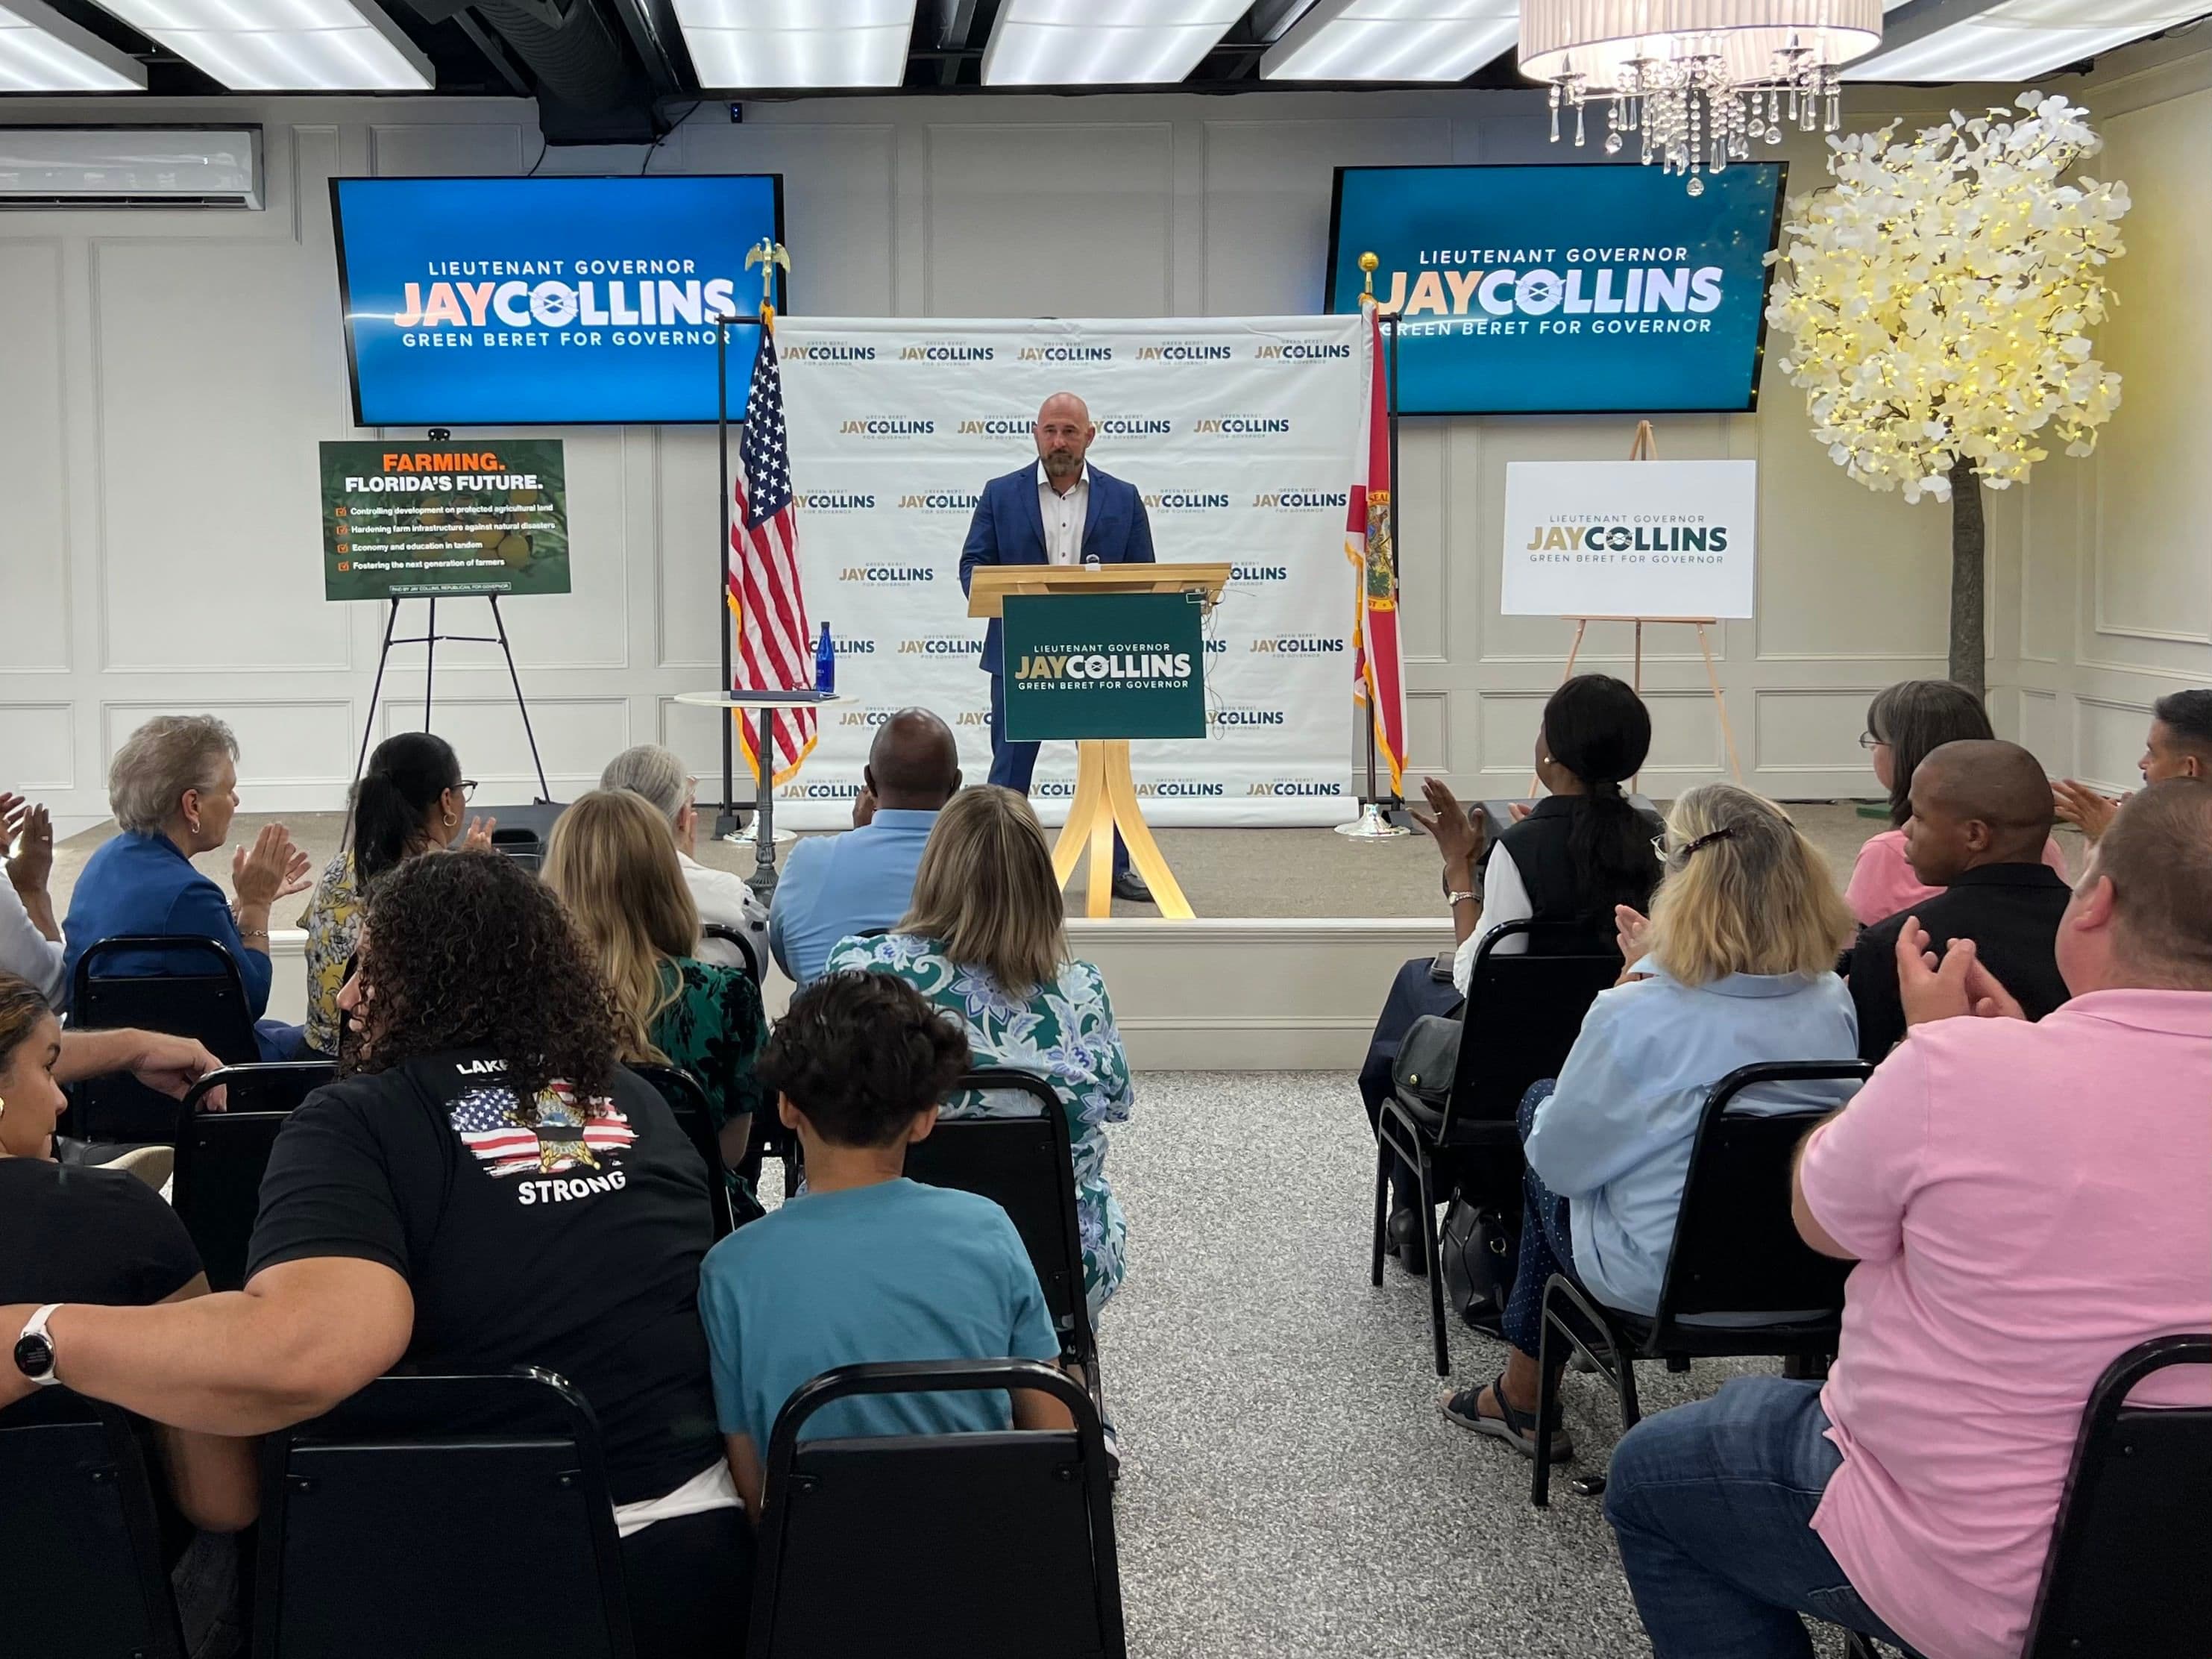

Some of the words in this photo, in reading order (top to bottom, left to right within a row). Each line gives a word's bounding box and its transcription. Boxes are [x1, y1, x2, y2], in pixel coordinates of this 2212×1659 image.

[1420, 249, 1556, 264] LIEUTENANT
[1566, 247, 1688, 262] GOVERNOR
[429, 260, 565, 275] LIEUTENANT
[575, 260, 695, 275] GOVERNOR
[1462, 321, 1529, 336] BERET
[1540, 320, 1580, 335] FOR
[1592, 319, 1711, 334] GOVERNOR
[403, 332, 473, 347] GREEN
[484, 331, 550, 347] BERET
[561, 330, 602, 346] FOR
[383, 453, 506, 471] FARMING.
[456, 474, 543, 490] FUTURE.
[351, 507, 393, 516] Controlling
[394, 507, 444, 515] development
[456, 506, 493, 515] protected
[494, 504, 535, 514] agricultural
[1550, 515, 1627, 523] LIEUTENANT
[1634, 515, 1705, 523] GOVERNOR
[351, 525, 392, 534] Hardening
[465, 523, 493, 532] against
[352, 544, 389, 552] Economy
[353, 561, 390, 570] Fostering
[424, 559, 465, 569] generation
[1530, 554, 1570, 562] GREEN
[1577, 554, 1614, 562] BERET
[1621, 555, 1646, 563] FOR
[1652, 555, 1724, 564] GOVERNOR
[898, 641, 986, 653] JAYCOLLIN
[1034, 645, 1103, 653] LIEUTENANT
[1108, 643, 1170, 652] GOVERNOR
[1018, 682, 1055, 690] GREEN
[1060, 681, 1094, 690] BERET
[1099, 681, 1121, 689] FOR
[1126, 680, 1189, 689] GOVERNOR
[518, 1170, 626, 1205] STRONG
